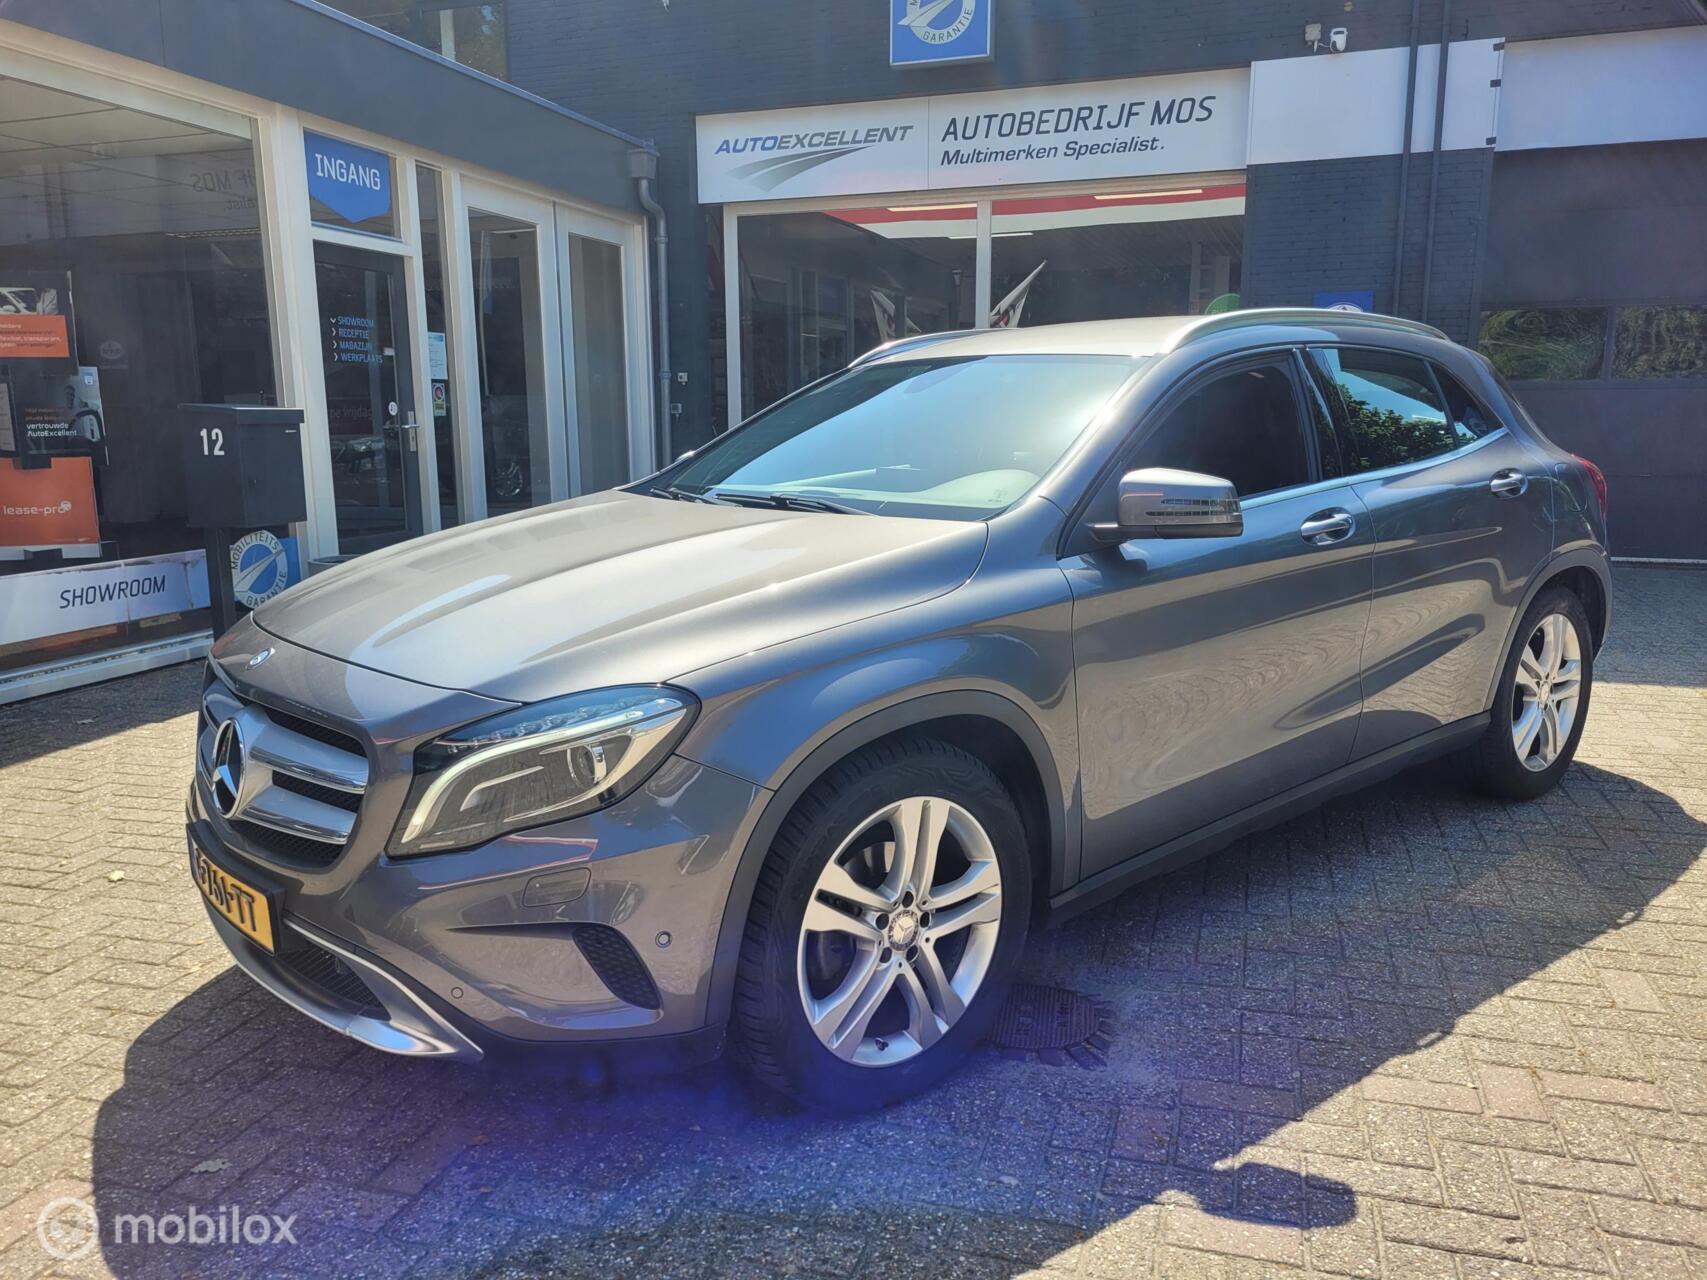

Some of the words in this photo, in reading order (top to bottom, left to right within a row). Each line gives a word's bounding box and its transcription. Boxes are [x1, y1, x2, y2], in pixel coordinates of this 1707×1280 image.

[922, 8, 973, 42] GARANTIE
[941, 101, 1145, 142] AUTOBEDRIJF
[1150, 95, 1216, 126] MOS
[715, 125, 914, 154] AUTOEXCELLENT
[940, 144, 1058, 166] Multimerken
[1063, 136, 1165, 160] Specialist.
[315, 153, 381, 191] INGANG
[337, 316, 374, 327] SHOWROOM
[338, 328, 369, 339] RECEPTIE
[26, 422, 69, 430] vertrouwde
[200, 428, 225, 456] 12
[231, 531, 279, 570] MOBILITEITS
[60, 575, 166, 609] SHOWROOM
